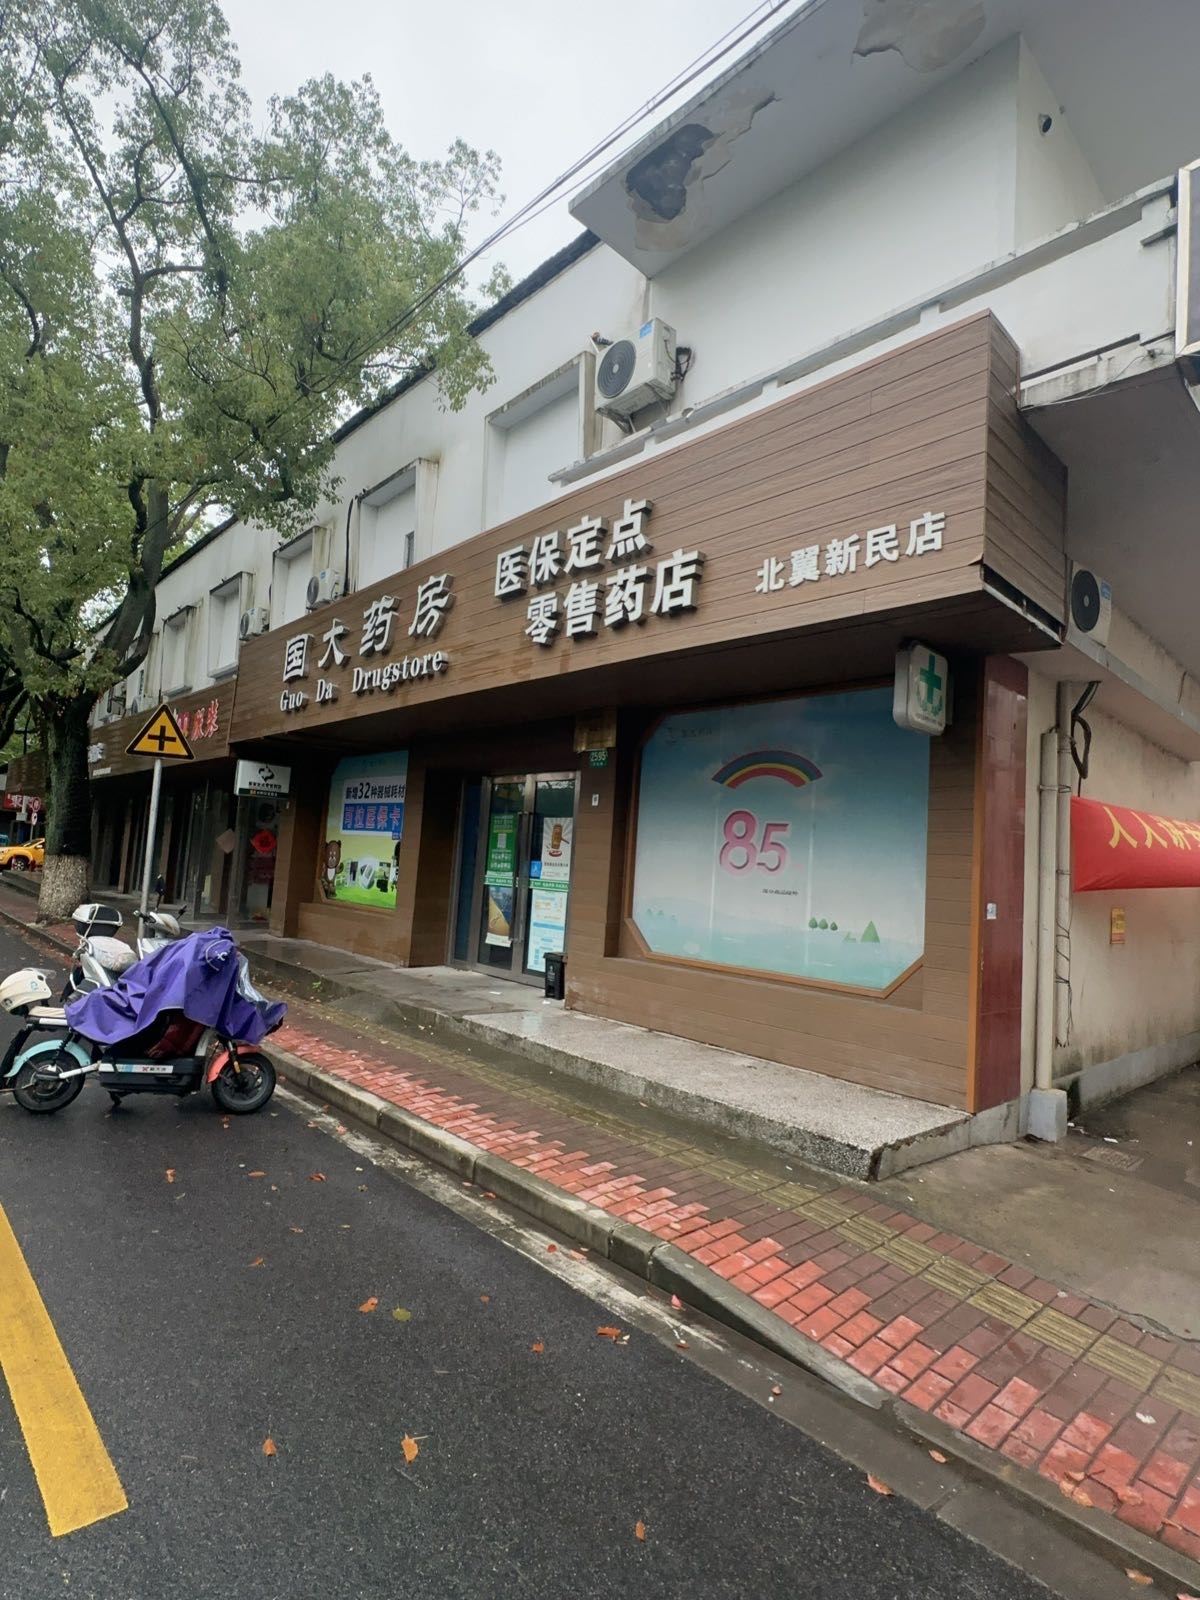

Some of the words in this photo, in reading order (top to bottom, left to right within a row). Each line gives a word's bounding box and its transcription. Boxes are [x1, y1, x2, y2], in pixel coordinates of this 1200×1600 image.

[494, 499, 654, 600] 医保定点
[754, 511, 946, 594] 北翼新民店
[283, 574, 456, 683] 国大药房
[525, 548, 705, 647] 零售药店
[280, 690, 306, 713] Guo
[315, 679, 336, 704] Da
[351, 650, 448, 696] Drugstore
[719, 808, 791, 876] 85
